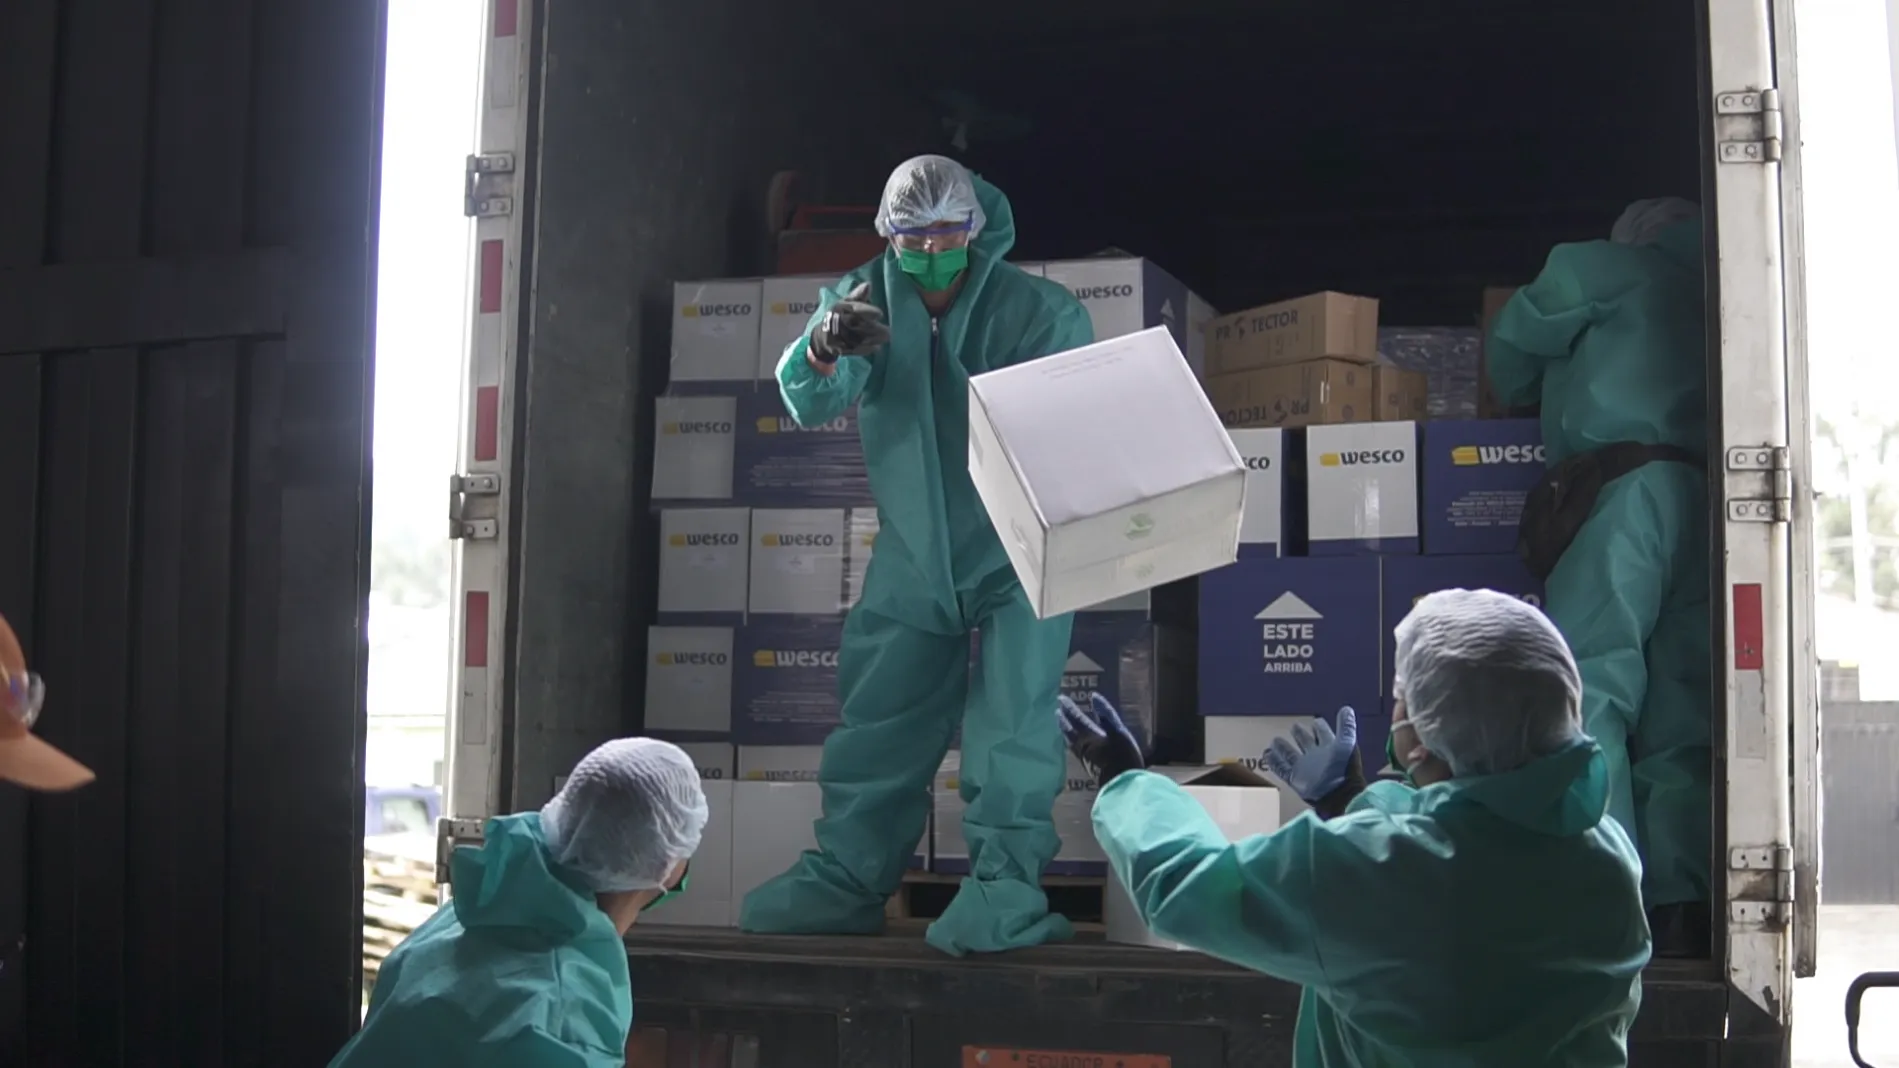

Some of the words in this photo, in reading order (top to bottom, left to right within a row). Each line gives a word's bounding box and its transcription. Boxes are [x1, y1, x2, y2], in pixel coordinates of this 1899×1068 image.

[1075, 284, 1133, 300] wesco
[700, 302, 752, 316] wesco
[679, 421, 732, 434] wesco
[1340, 448, 1405, 465] wesco
[1480, 444, 1546, 464] wesc
[686, 532, 739, 546] wesco
[779, 533, 834, 547] wesco
[1263, 623, 1314, 640] ESTE
[674, 651, 727, 665] wesco
[1263, 644, 1314, 659] LADO
[1264, 662, 1313, 673] ARRIBA
[1060, 675, 1099, 688] ESTE
